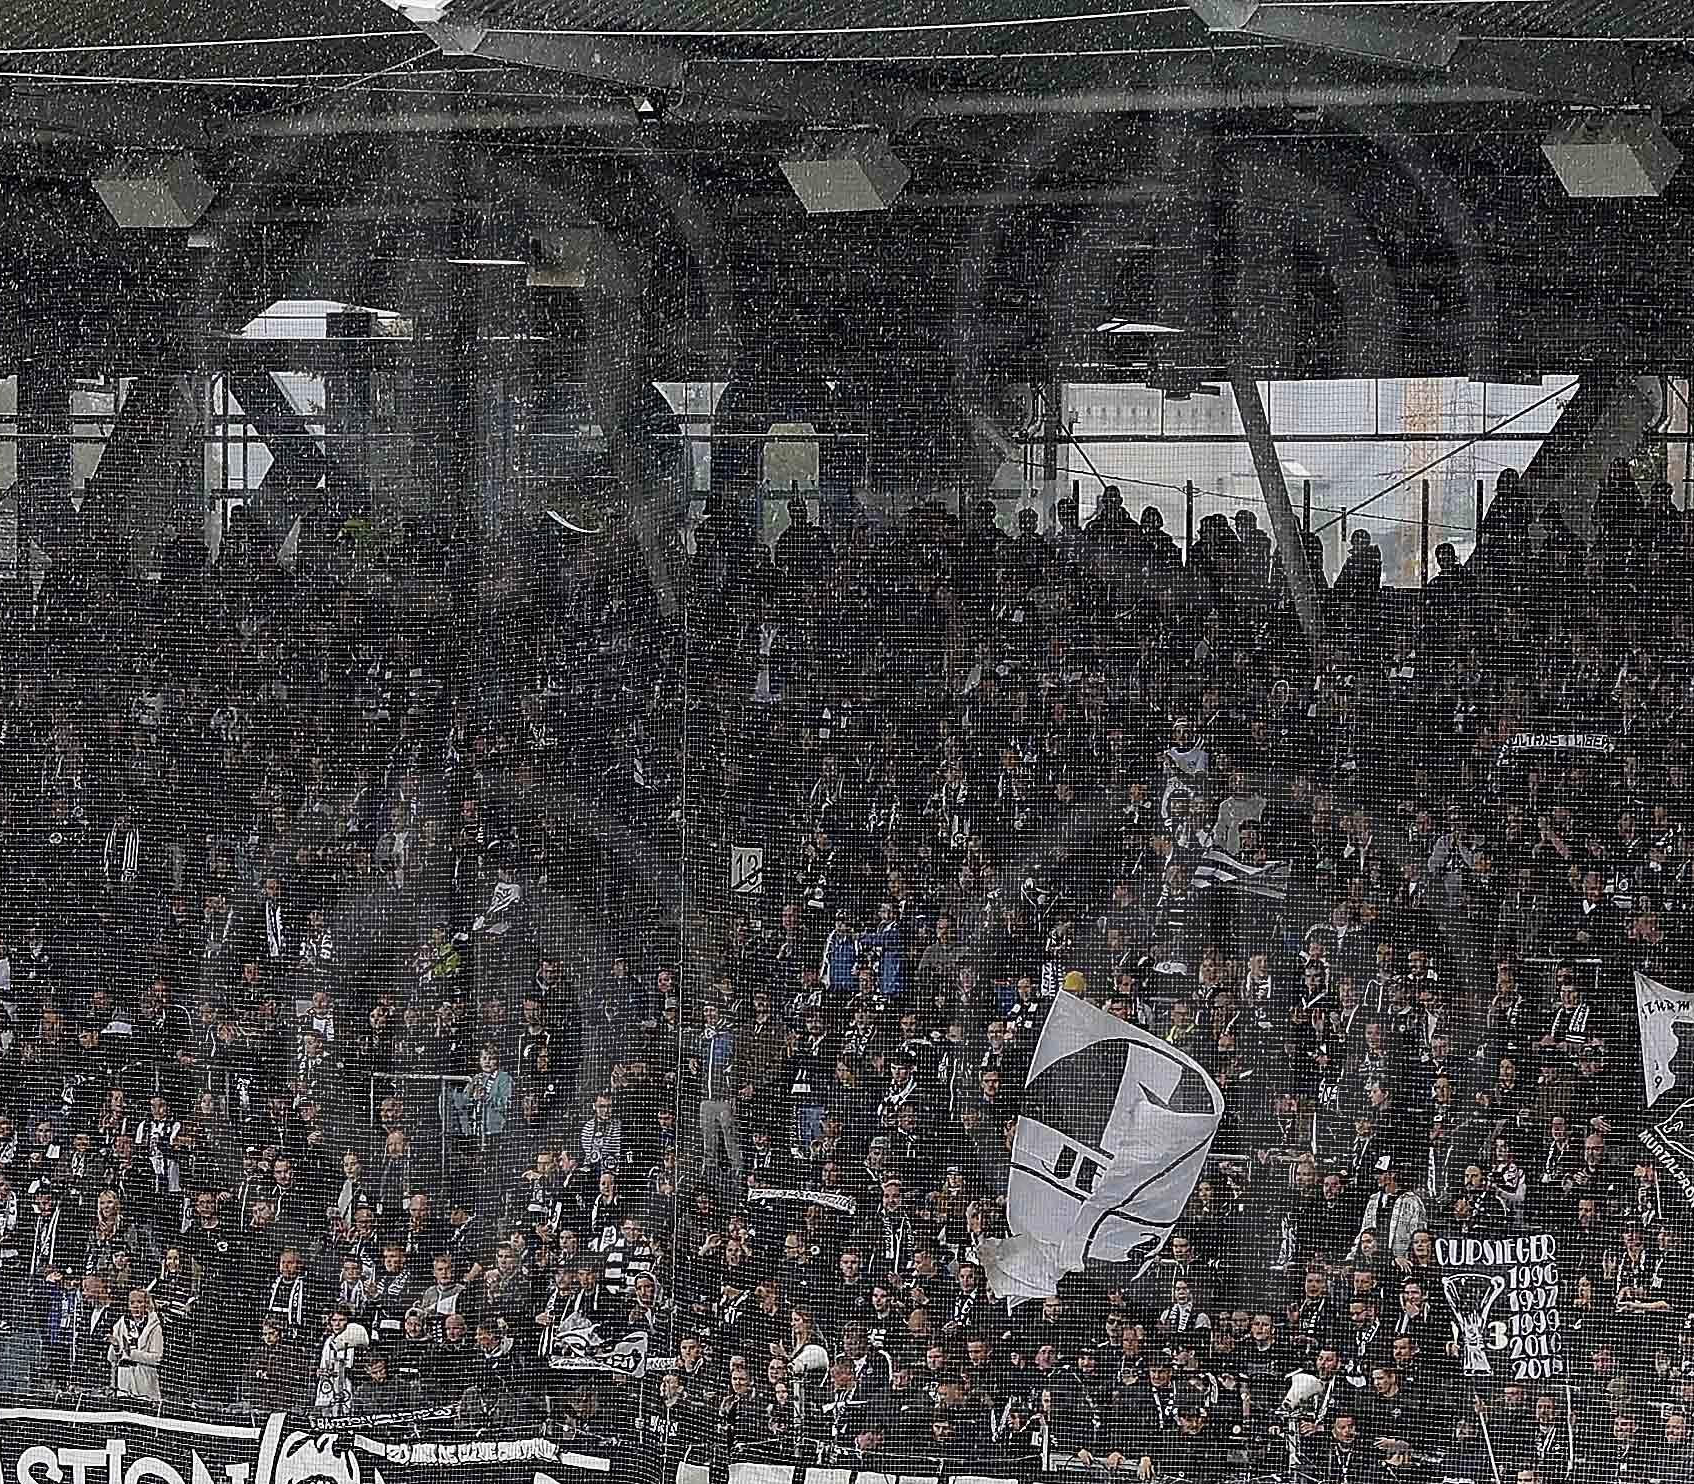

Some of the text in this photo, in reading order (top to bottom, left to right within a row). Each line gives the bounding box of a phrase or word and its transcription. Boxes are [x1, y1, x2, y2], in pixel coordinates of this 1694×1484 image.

[1435, 1234, 1556, 1266] CUPSIEGER
[1507, 1263, 1558, 1290] 1996
[1507, 1286, 1558, 1312] 1997
